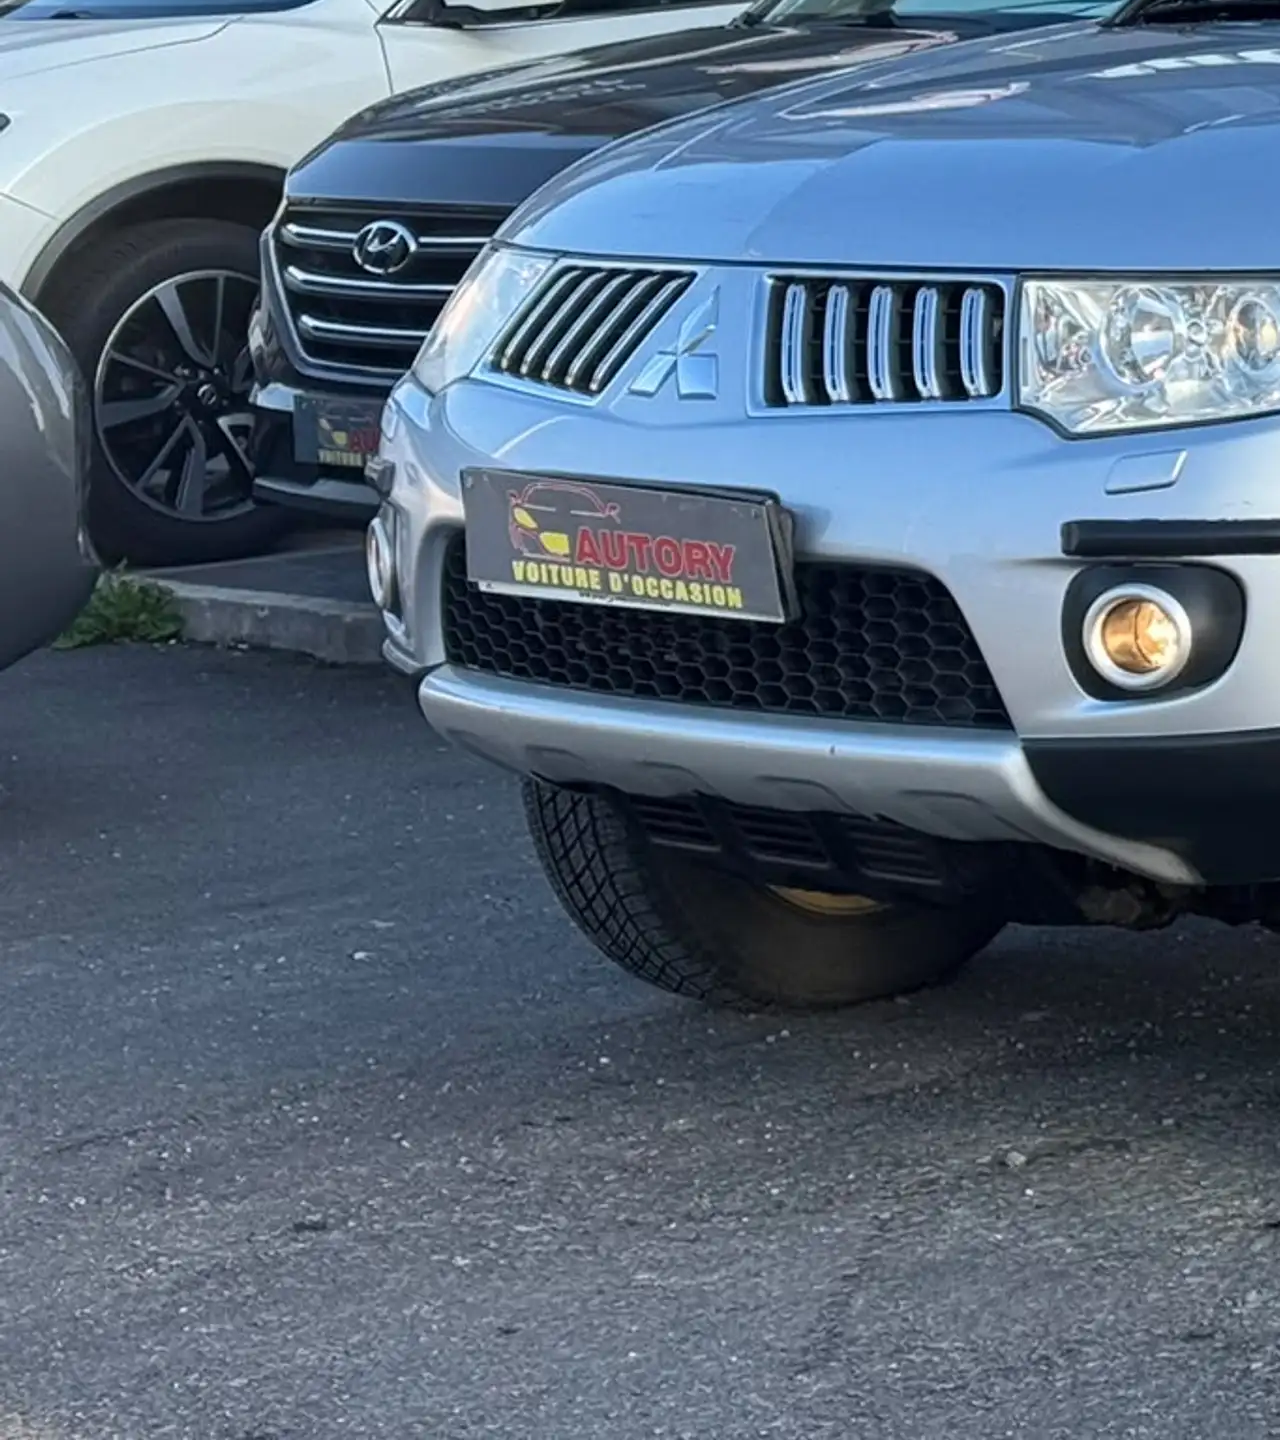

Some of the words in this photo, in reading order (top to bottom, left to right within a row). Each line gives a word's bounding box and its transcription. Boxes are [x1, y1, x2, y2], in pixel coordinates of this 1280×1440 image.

[575, 525, 736, 584] AUTORY
[511, 560, 601, 591] VOITURE
[609, 571, 744, 610] D'OCCASION
